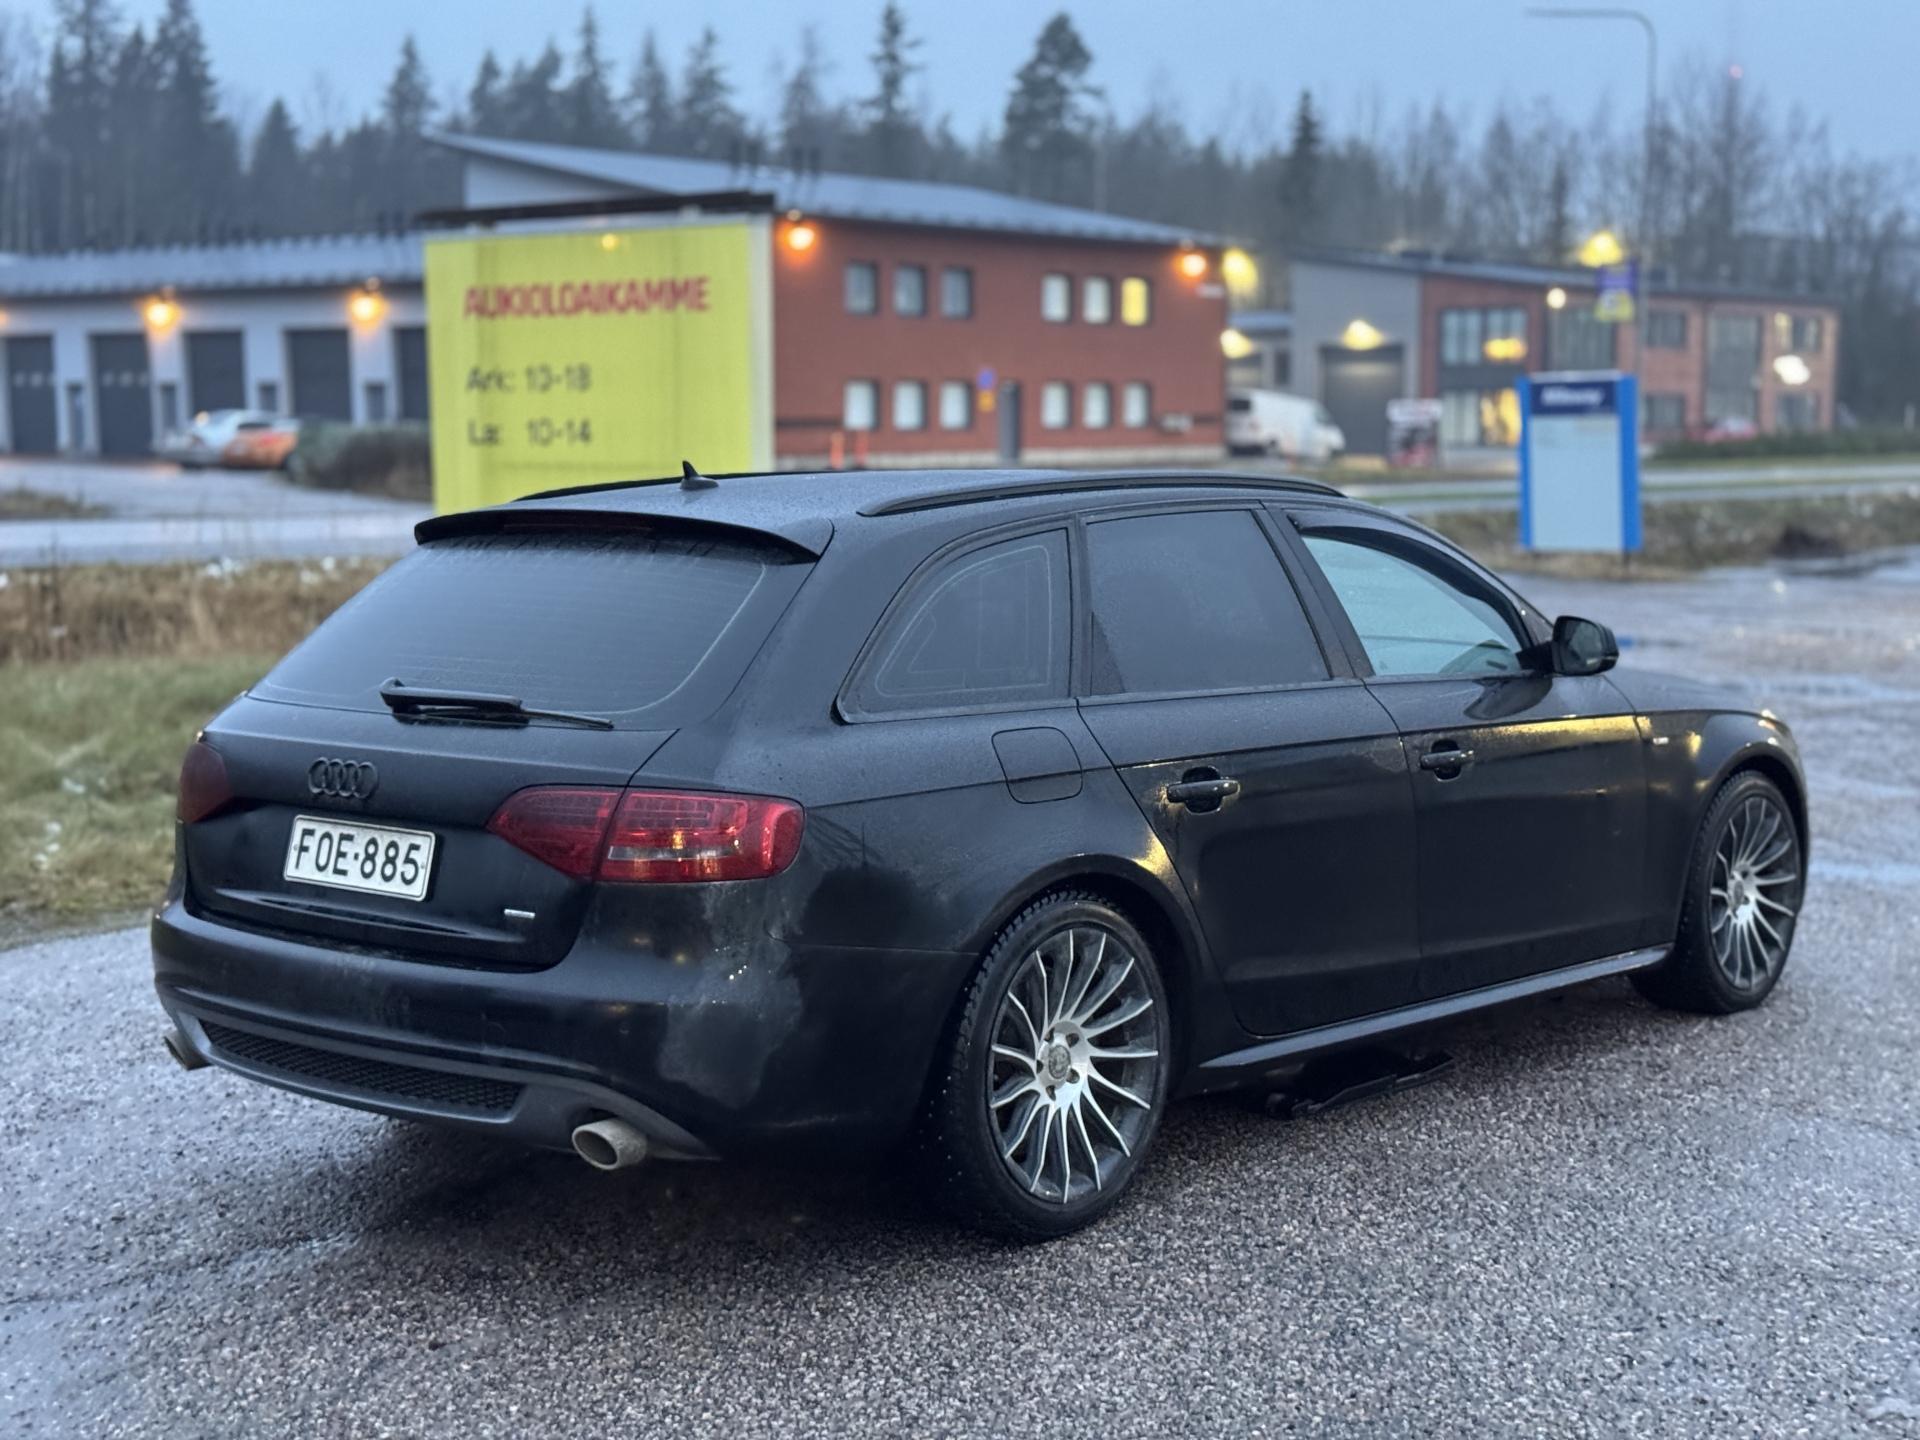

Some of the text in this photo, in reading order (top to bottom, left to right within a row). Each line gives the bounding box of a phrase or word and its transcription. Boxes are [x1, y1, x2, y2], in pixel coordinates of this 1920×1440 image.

[465, 278, 709, 318] AUKIOLOAIKAMME
[525, 363, 592, 391] 10-18
[527, 418, 592, 446] 10-14
[295, 828, 421, 885] FOE-885
